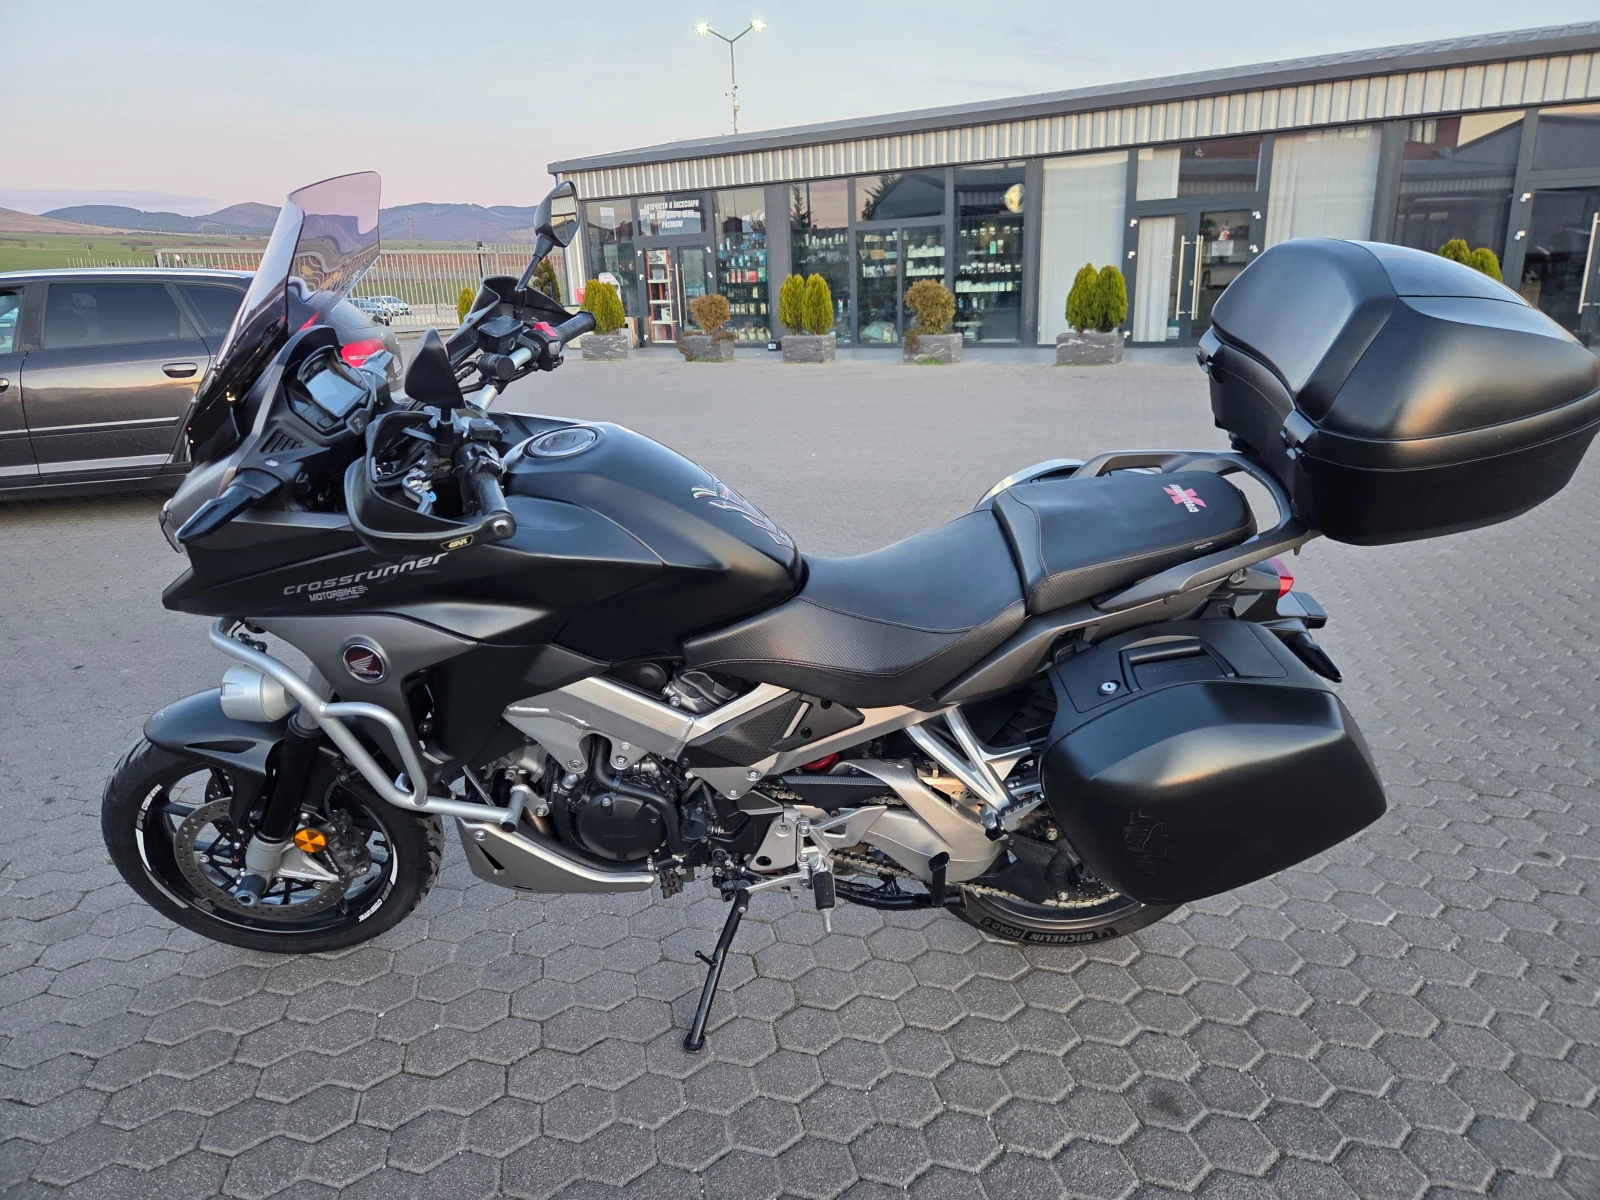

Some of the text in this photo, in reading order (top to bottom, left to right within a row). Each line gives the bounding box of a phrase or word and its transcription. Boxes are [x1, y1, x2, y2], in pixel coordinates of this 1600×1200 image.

[673, 199, 700, 208] АКСЕСОАРИ
[283, 552, 449, 596] crossrunner
[983, 918, 1023, 938] ROAD 6
[1029, 931, 1093, 943] MICHELIN
